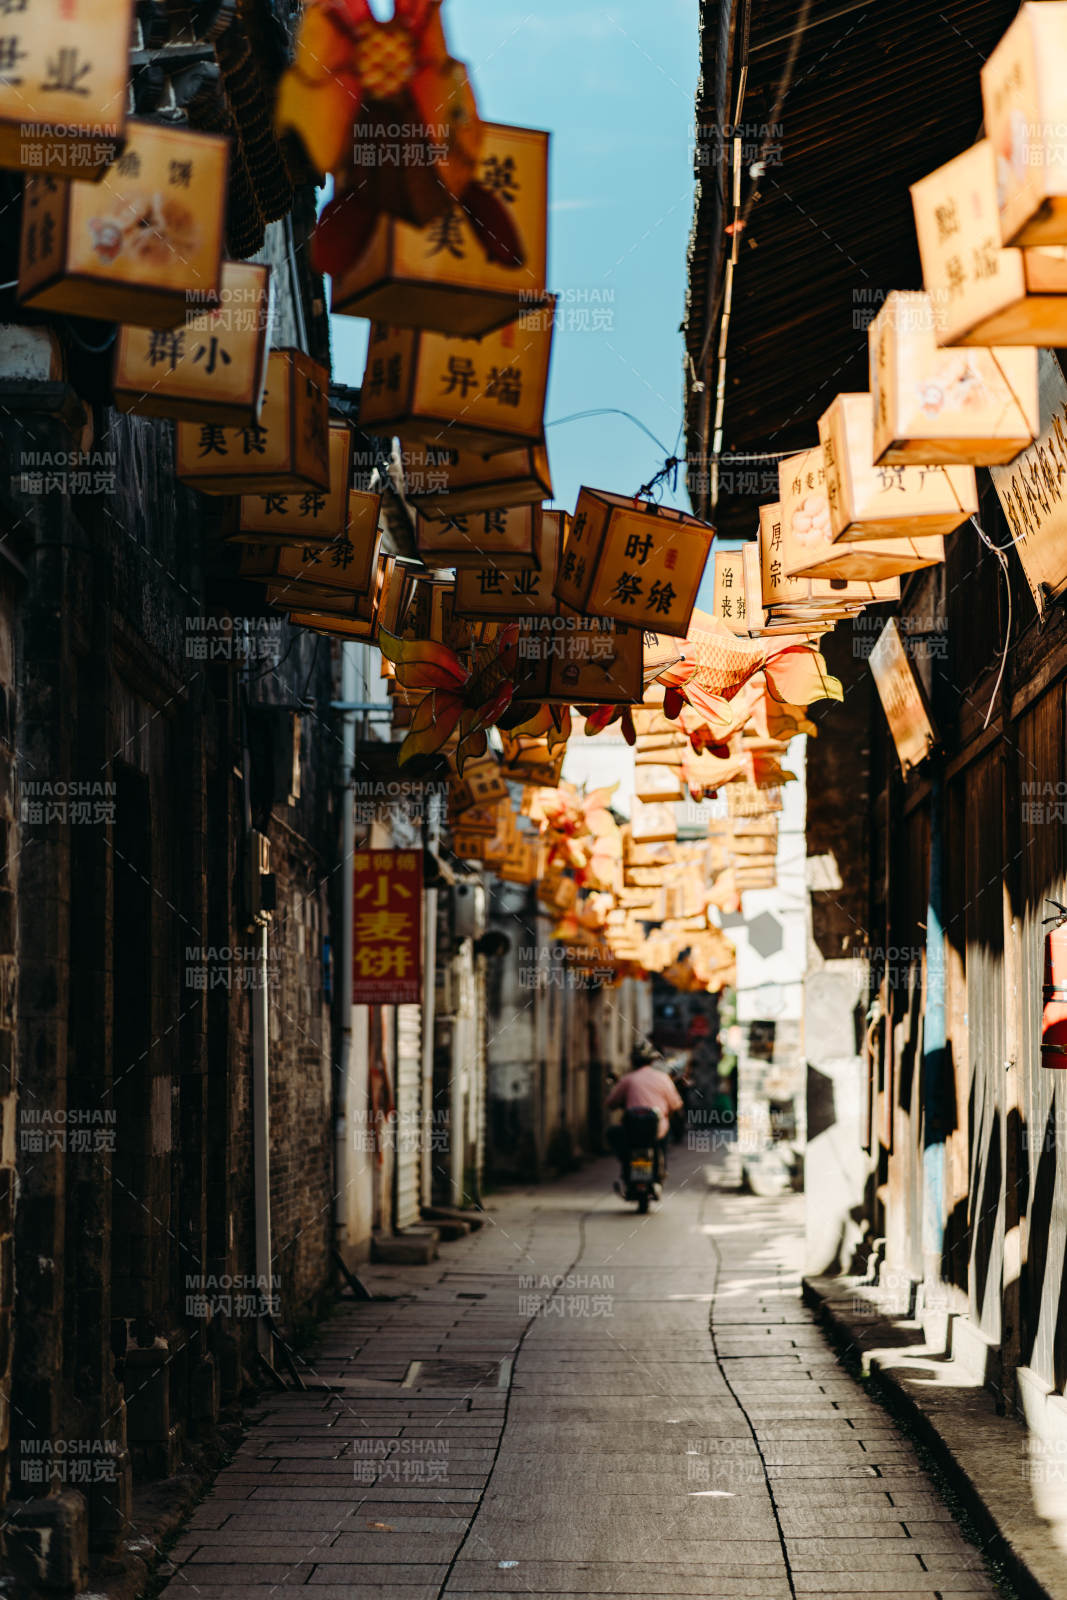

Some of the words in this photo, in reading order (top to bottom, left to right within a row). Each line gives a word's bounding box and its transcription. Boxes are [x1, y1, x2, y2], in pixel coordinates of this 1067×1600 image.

[147, 330, 232, 374] 群小
[439, 356, 523, 408] 异端
[197, 423, 268, 458] 美食
[624, 533, 654, 566] 时
[768, 522, 783, 552] 厚
[476, 568, 540, 597] 世业
[610, 570, 678, 616] 祭飨
[721, 567, 734, 588] 治
[356, 875, 414, 978] 小麦饼
